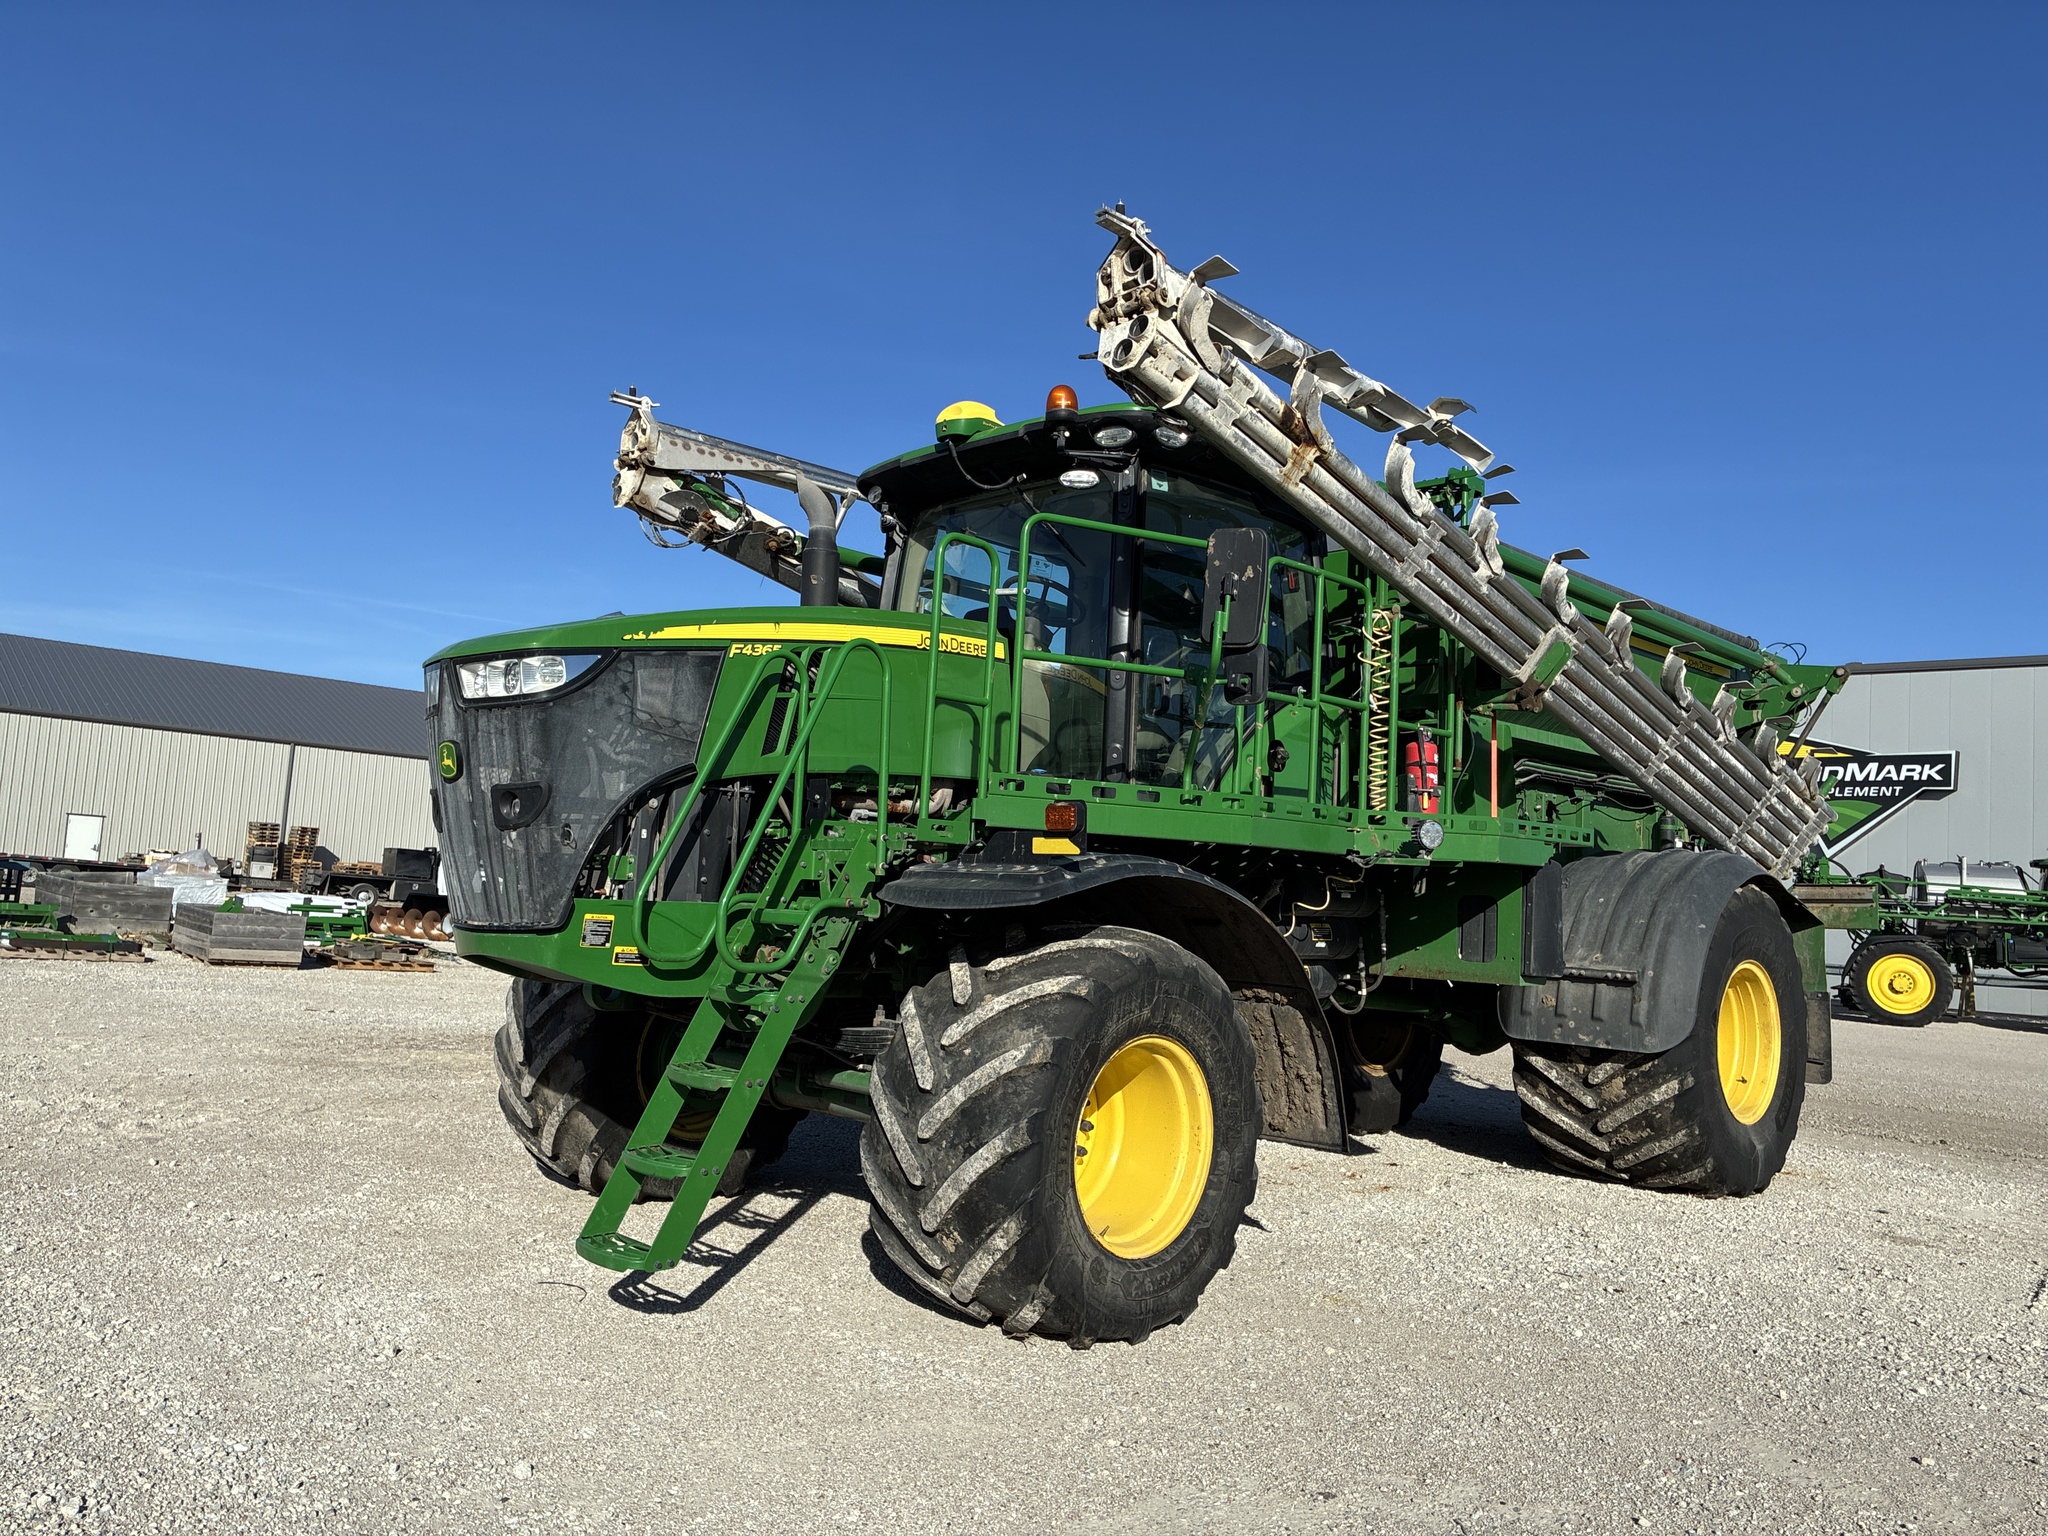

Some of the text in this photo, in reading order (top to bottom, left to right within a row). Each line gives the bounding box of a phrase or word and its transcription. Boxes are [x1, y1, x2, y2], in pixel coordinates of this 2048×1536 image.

[917, 634, 987, 655] JON DEERE
[1817, 762, 1946, 782] DMARK
[1828, 786, 1904, 797] LEMENT
